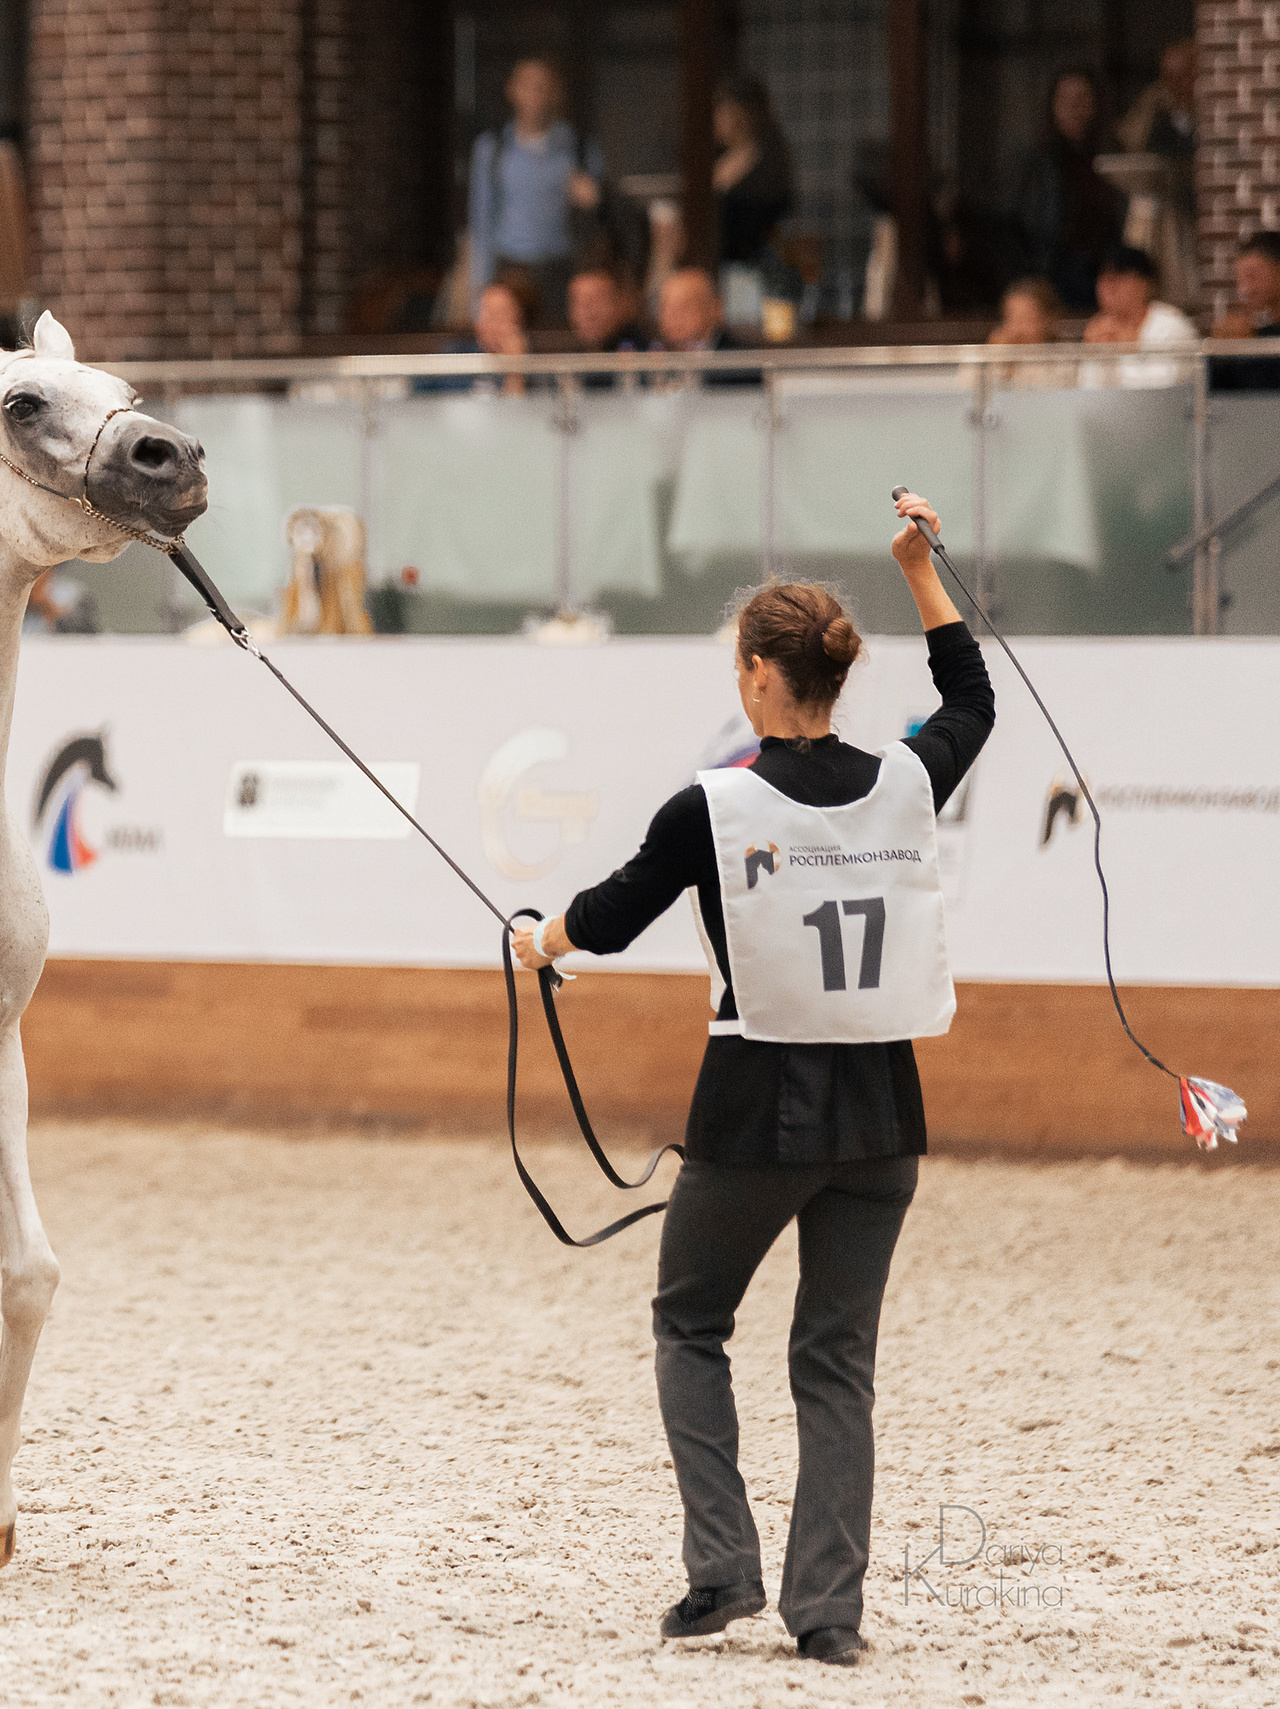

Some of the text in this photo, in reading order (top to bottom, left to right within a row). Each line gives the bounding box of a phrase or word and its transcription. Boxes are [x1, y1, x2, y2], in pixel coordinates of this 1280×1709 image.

[789, 845, 841, 854] АССОЦИАЦИЯ
[789, 849, 922, 867] РОСПЛЕМКОНЗАВОД
[802, 896, 886, 992] 17
